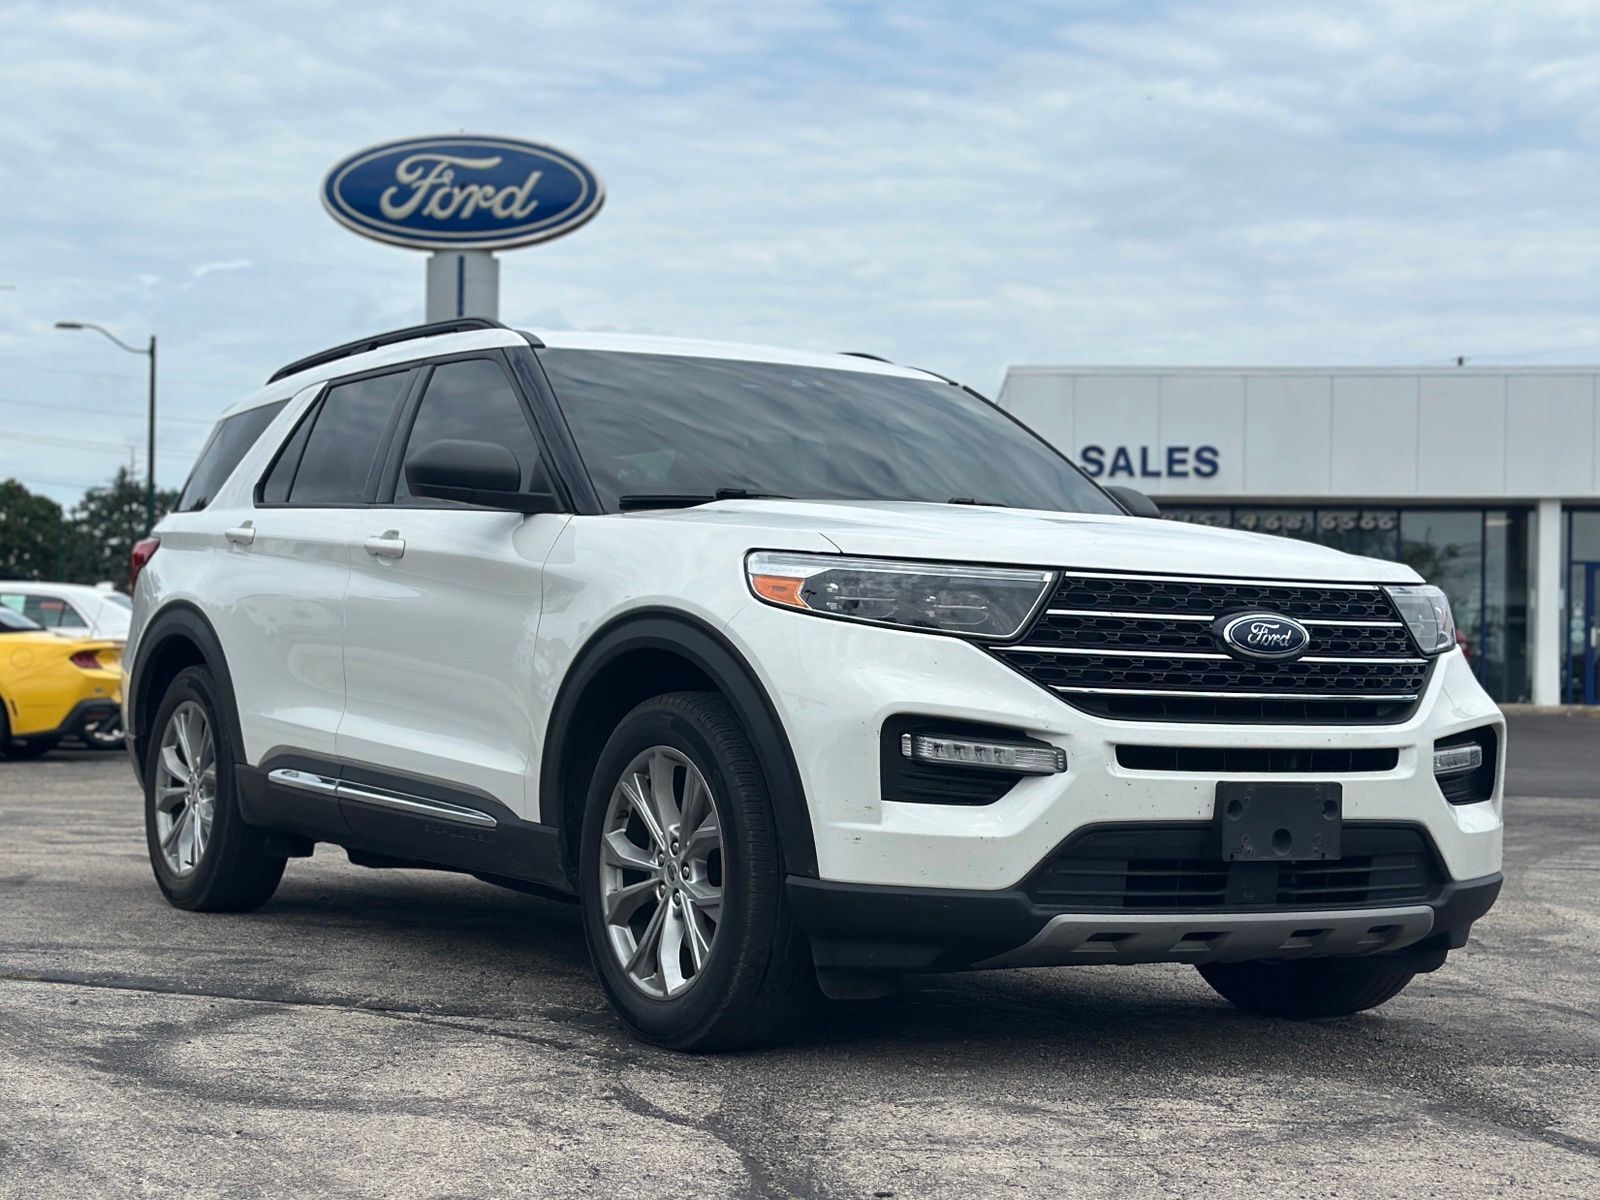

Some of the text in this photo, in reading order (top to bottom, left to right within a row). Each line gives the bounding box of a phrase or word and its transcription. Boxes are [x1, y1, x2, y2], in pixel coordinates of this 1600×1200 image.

[379, 153, 543, 220] Ford
[1080, 445, 1220, 478] SALES
[1247, 622, 1292, 647] Ford
